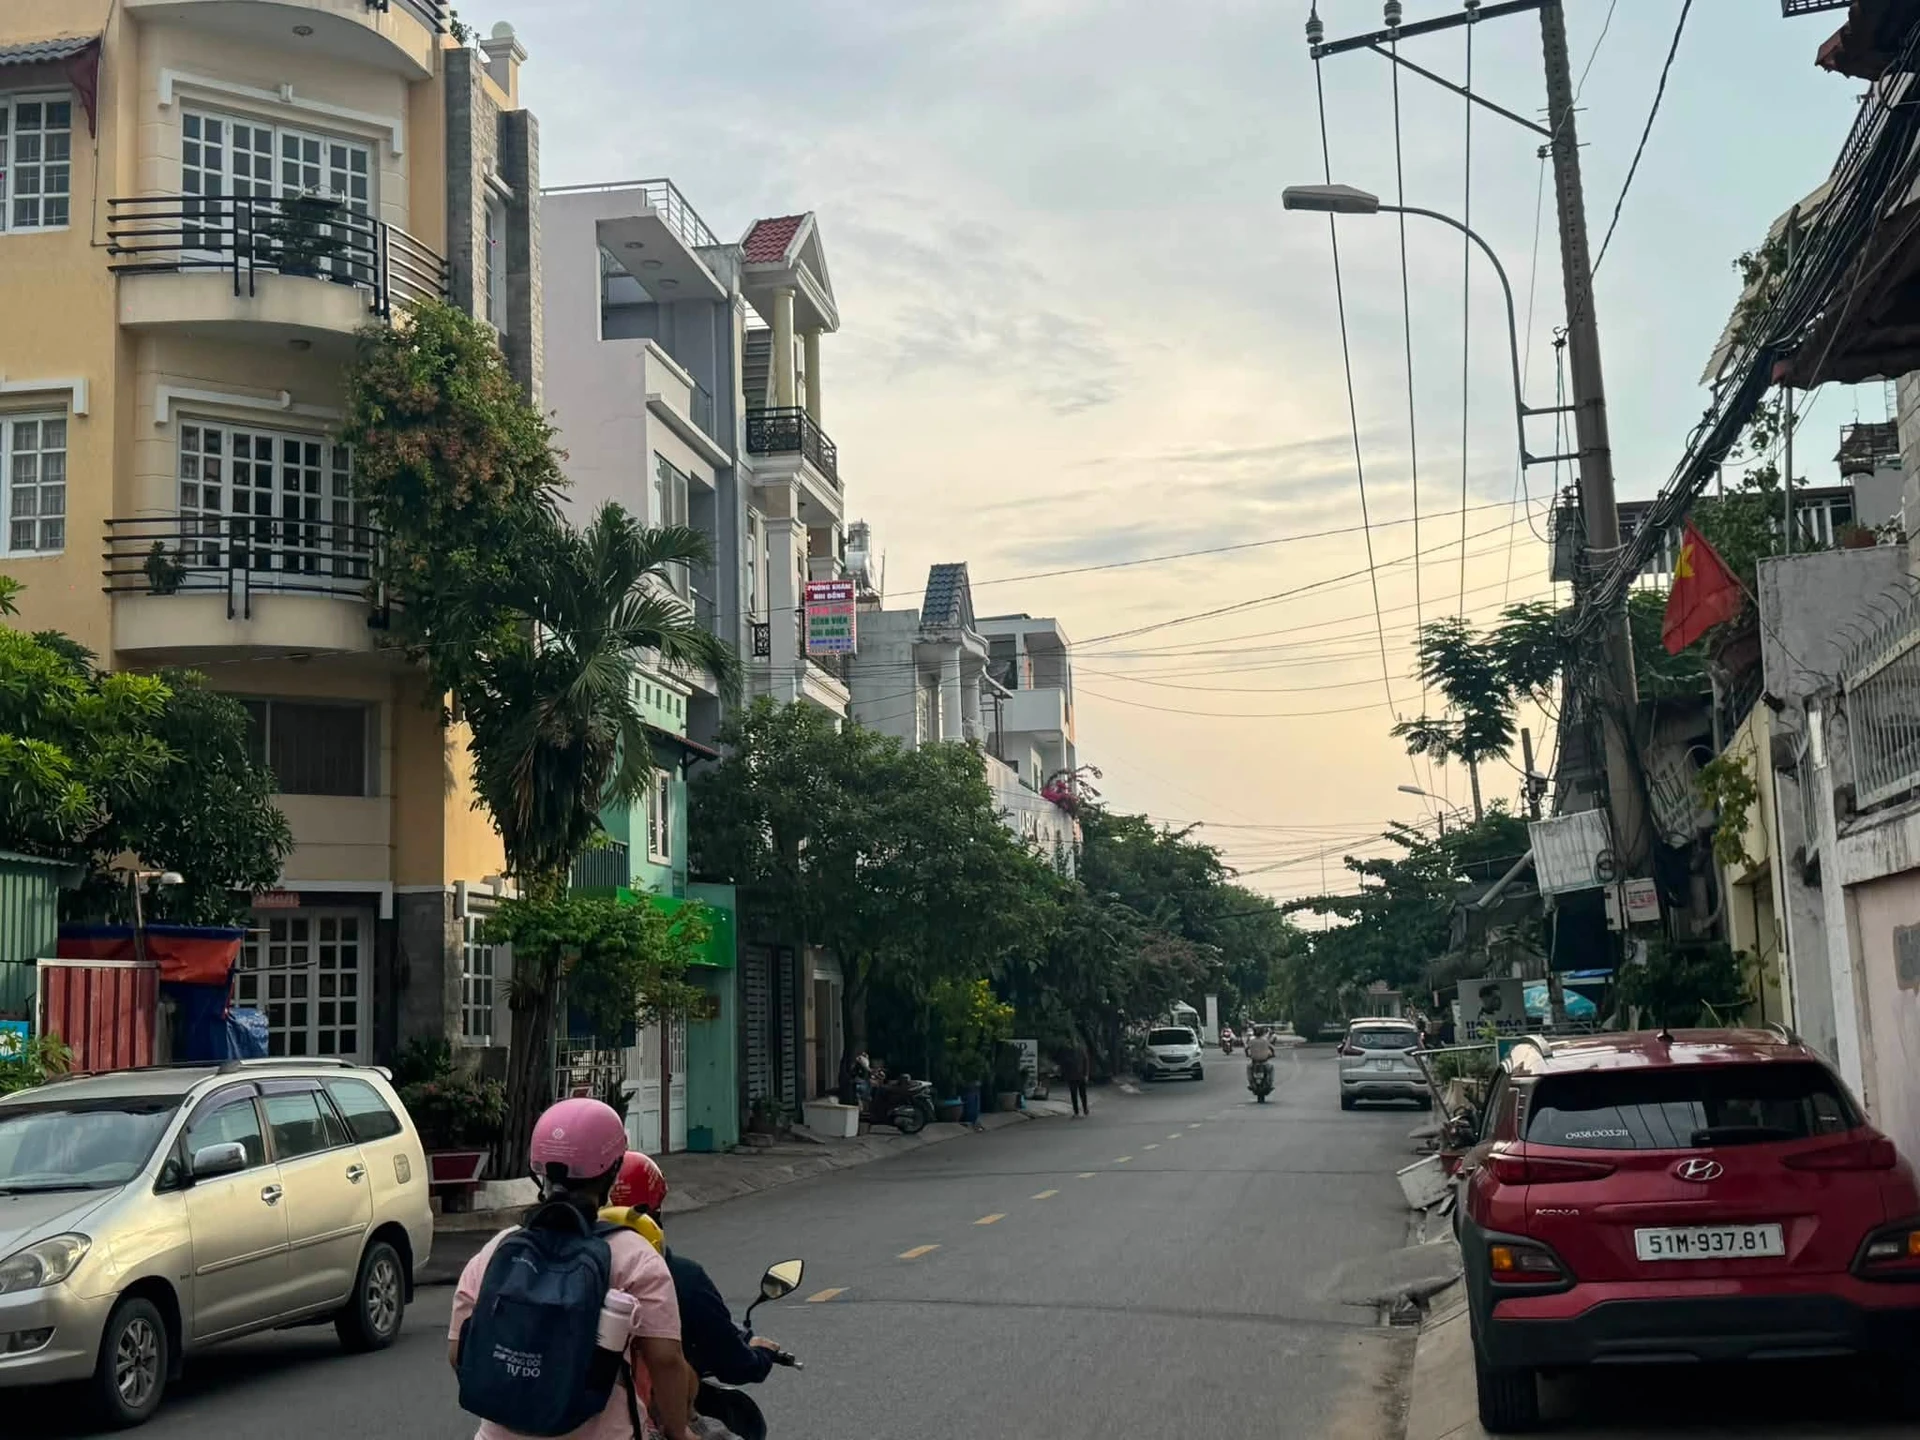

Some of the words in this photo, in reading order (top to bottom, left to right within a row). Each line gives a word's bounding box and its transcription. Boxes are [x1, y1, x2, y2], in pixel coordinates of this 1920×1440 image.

[1535, 1208, 1580, 1216] KONA
[1649, 1230, 1768, 1254] 51M-937.81
[506, 1362, 521, 1377] TỰ
[522, 1367, 541, 1378] DO
